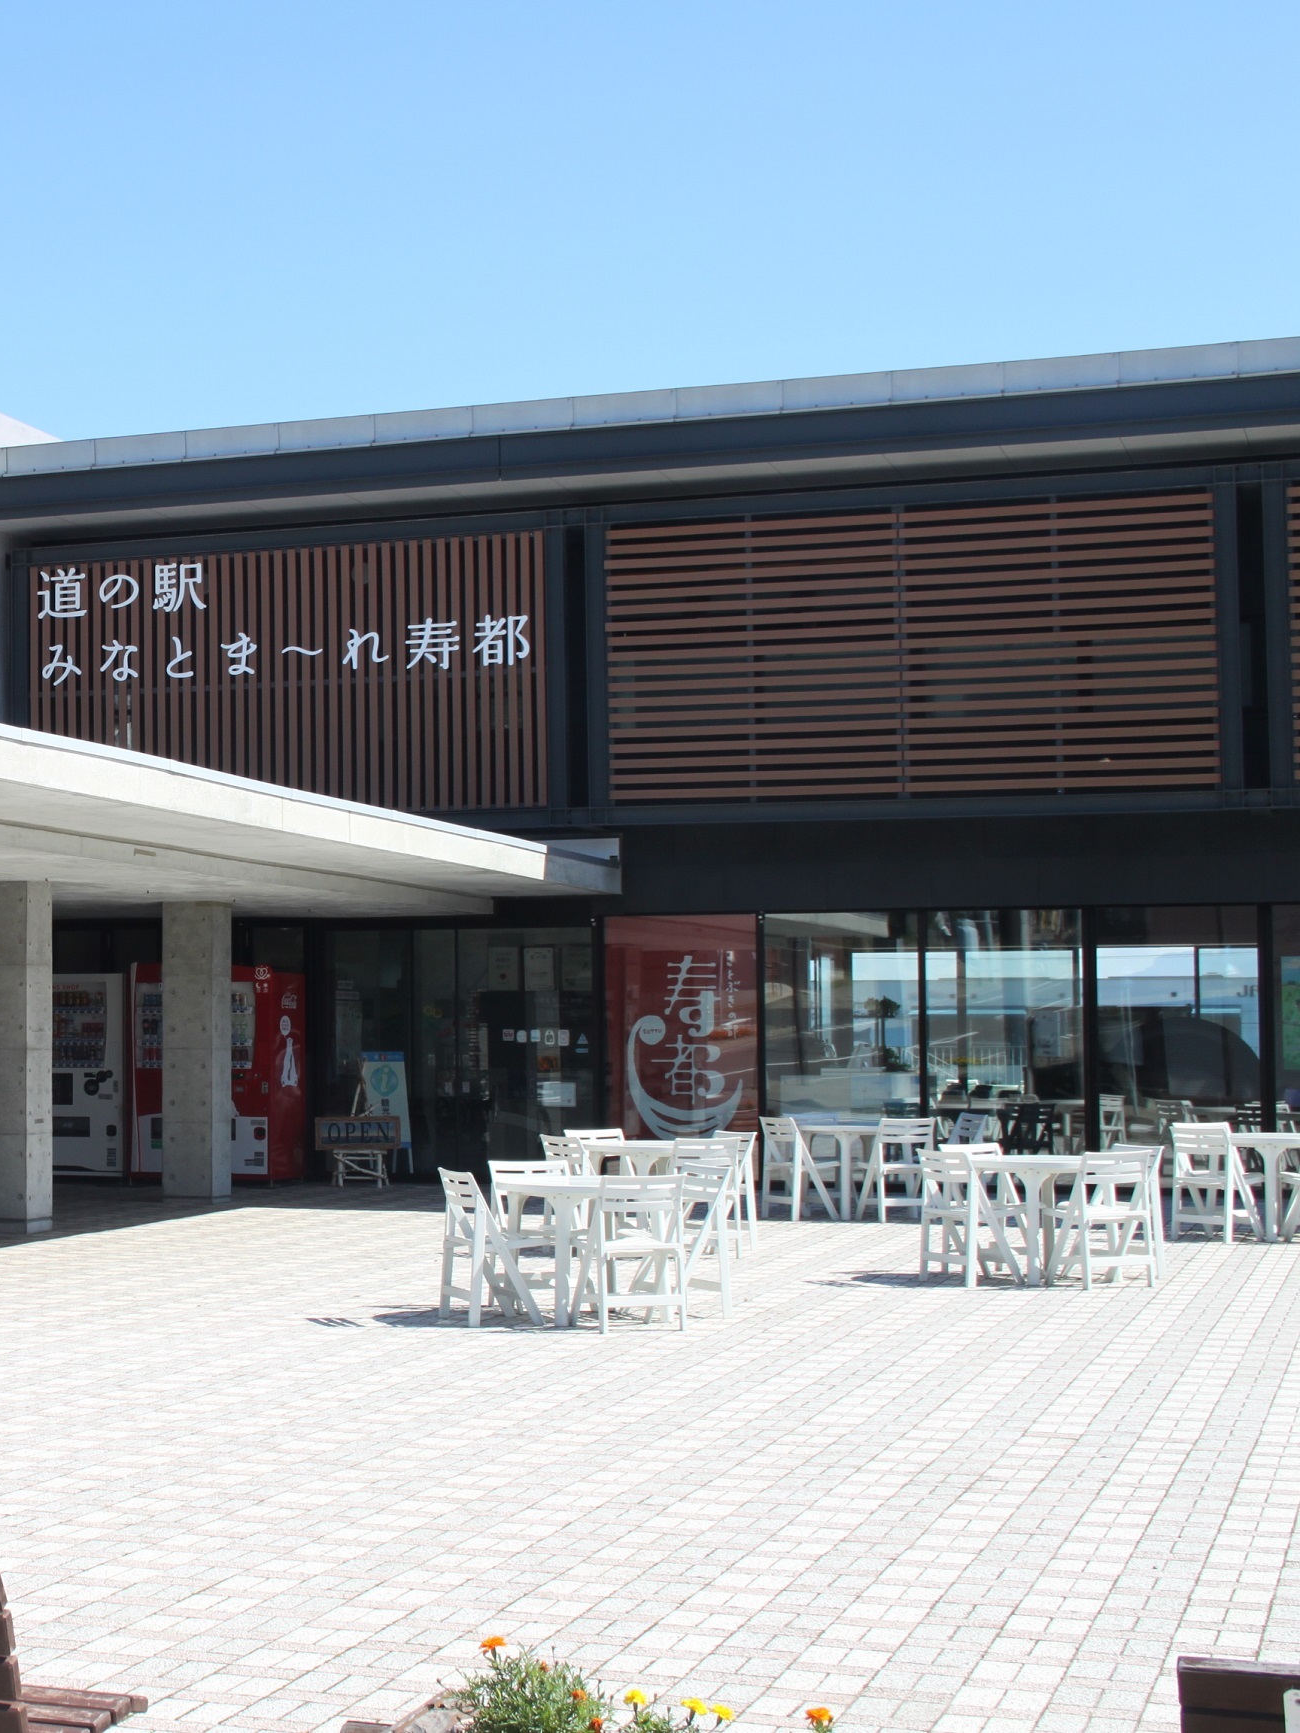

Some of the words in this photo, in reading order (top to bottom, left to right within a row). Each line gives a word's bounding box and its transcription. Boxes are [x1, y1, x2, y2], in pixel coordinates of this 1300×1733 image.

[36, 561, 207, 621] 道の駅
[327, 1121, 390, 1143] OPEN
